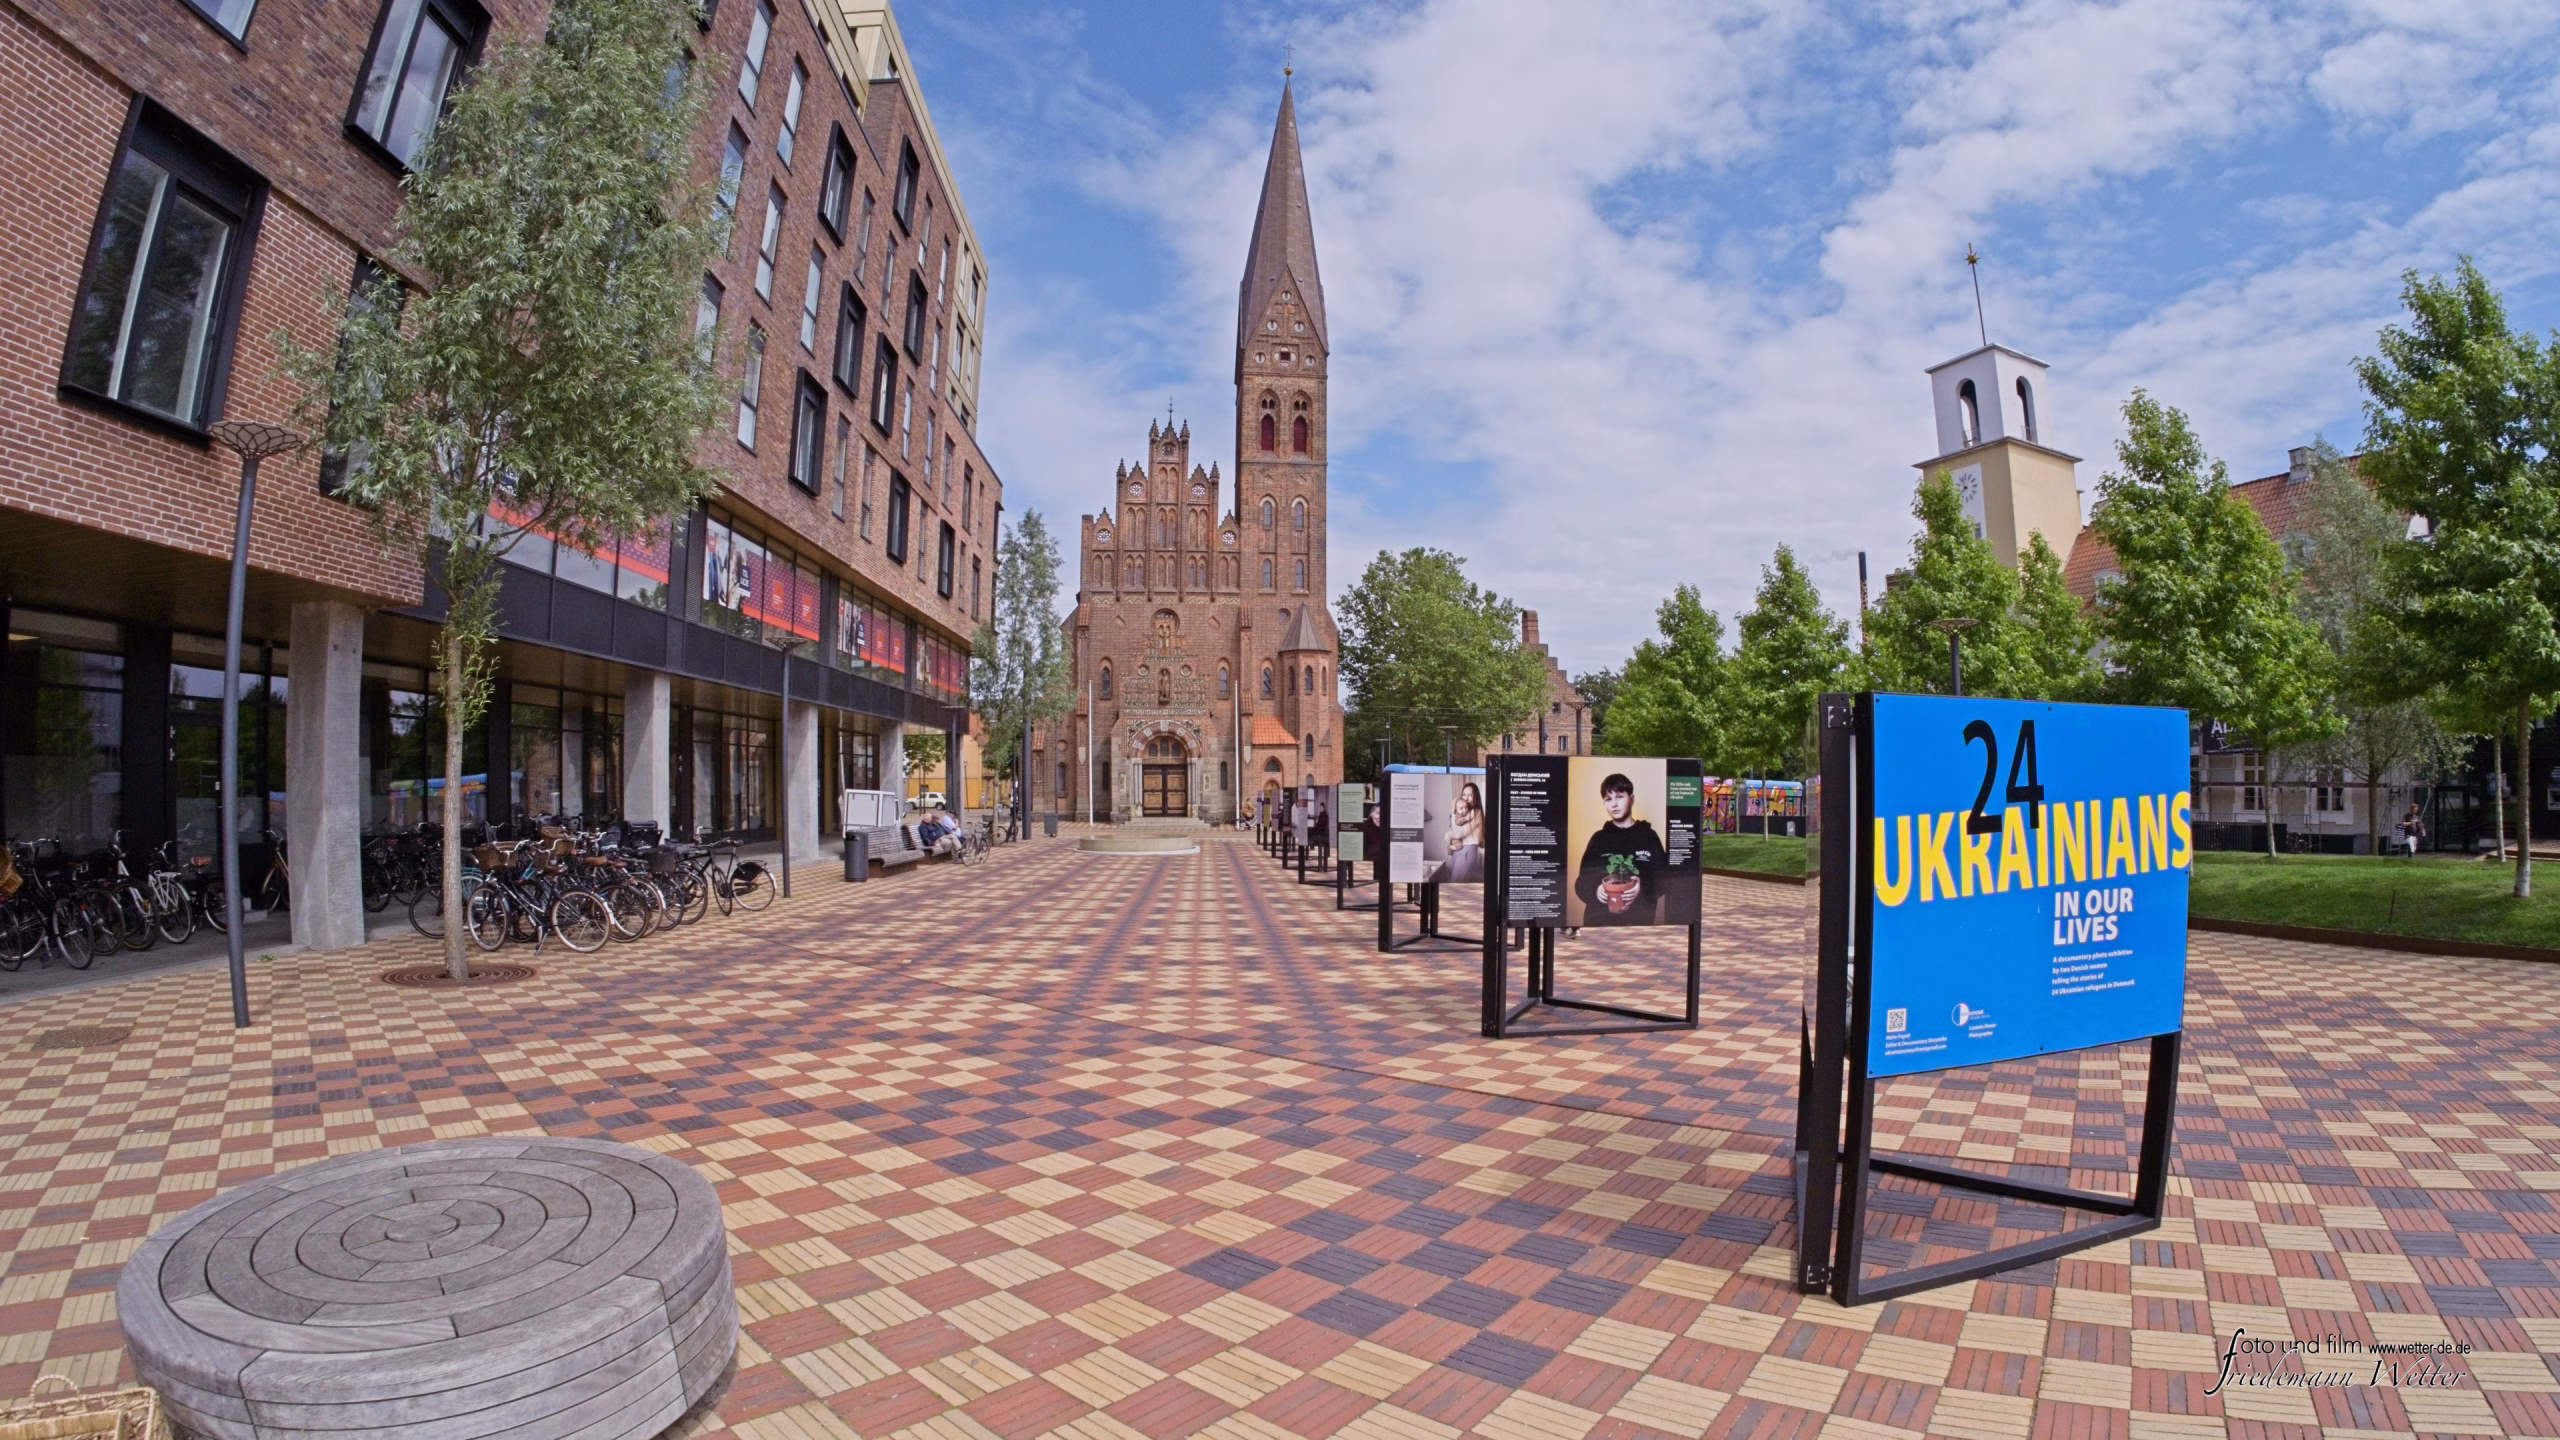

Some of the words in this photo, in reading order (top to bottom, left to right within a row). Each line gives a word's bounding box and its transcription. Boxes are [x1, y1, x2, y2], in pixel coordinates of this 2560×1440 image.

[1962, 719, 2045, 835] 24
[1873, 790, 2192, 907] UKRAINIANS
[2054, 890, 2080, 918] IN
[2084, 887, 2135, 915] OUR
[2053, 914, 2119, 946] LIVES
[2058, 953, 2092, 962] documentary
[2092, 952, 2108, 960] photo
[2108, 949, 2133, 957] exhibition
[2052, 966, 2059, 974] by
[2071, 964, 2089, 972] Danish
[2051, 977, 2069, 985] telling
[2059, 986, 2084, 995] Ukrainian
[2085, 983, 2107, 992] refugees
[2113, 979, 2135, 988] Denmark
